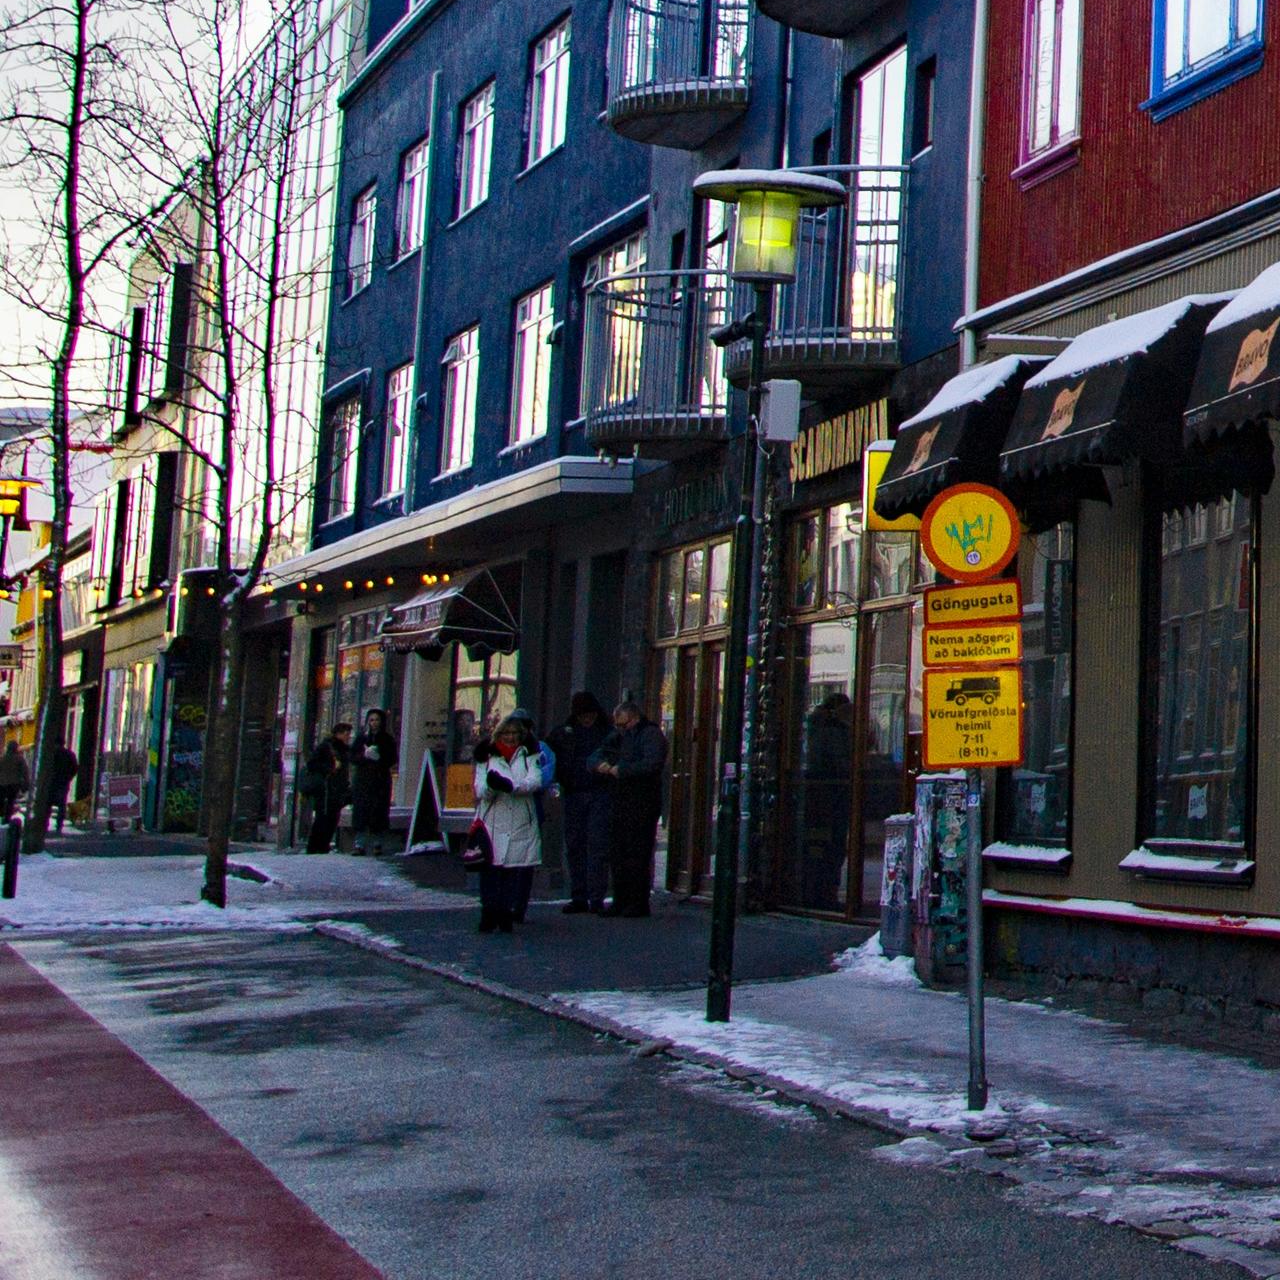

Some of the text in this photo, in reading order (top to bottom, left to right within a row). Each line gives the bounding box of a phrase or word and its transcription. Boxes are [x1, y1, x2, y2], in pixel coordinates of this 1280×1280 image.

[931, 593, 1014, 612] Göngugata
[929, 631, 1015, 646] Nema aðgengi
[934, 645, 1011, 659] að baklóðum
[955, 720, 992, 732] heimil
[963, 734, 984, 744] 7-11
[958, 746, 989, 759] (8-11)
